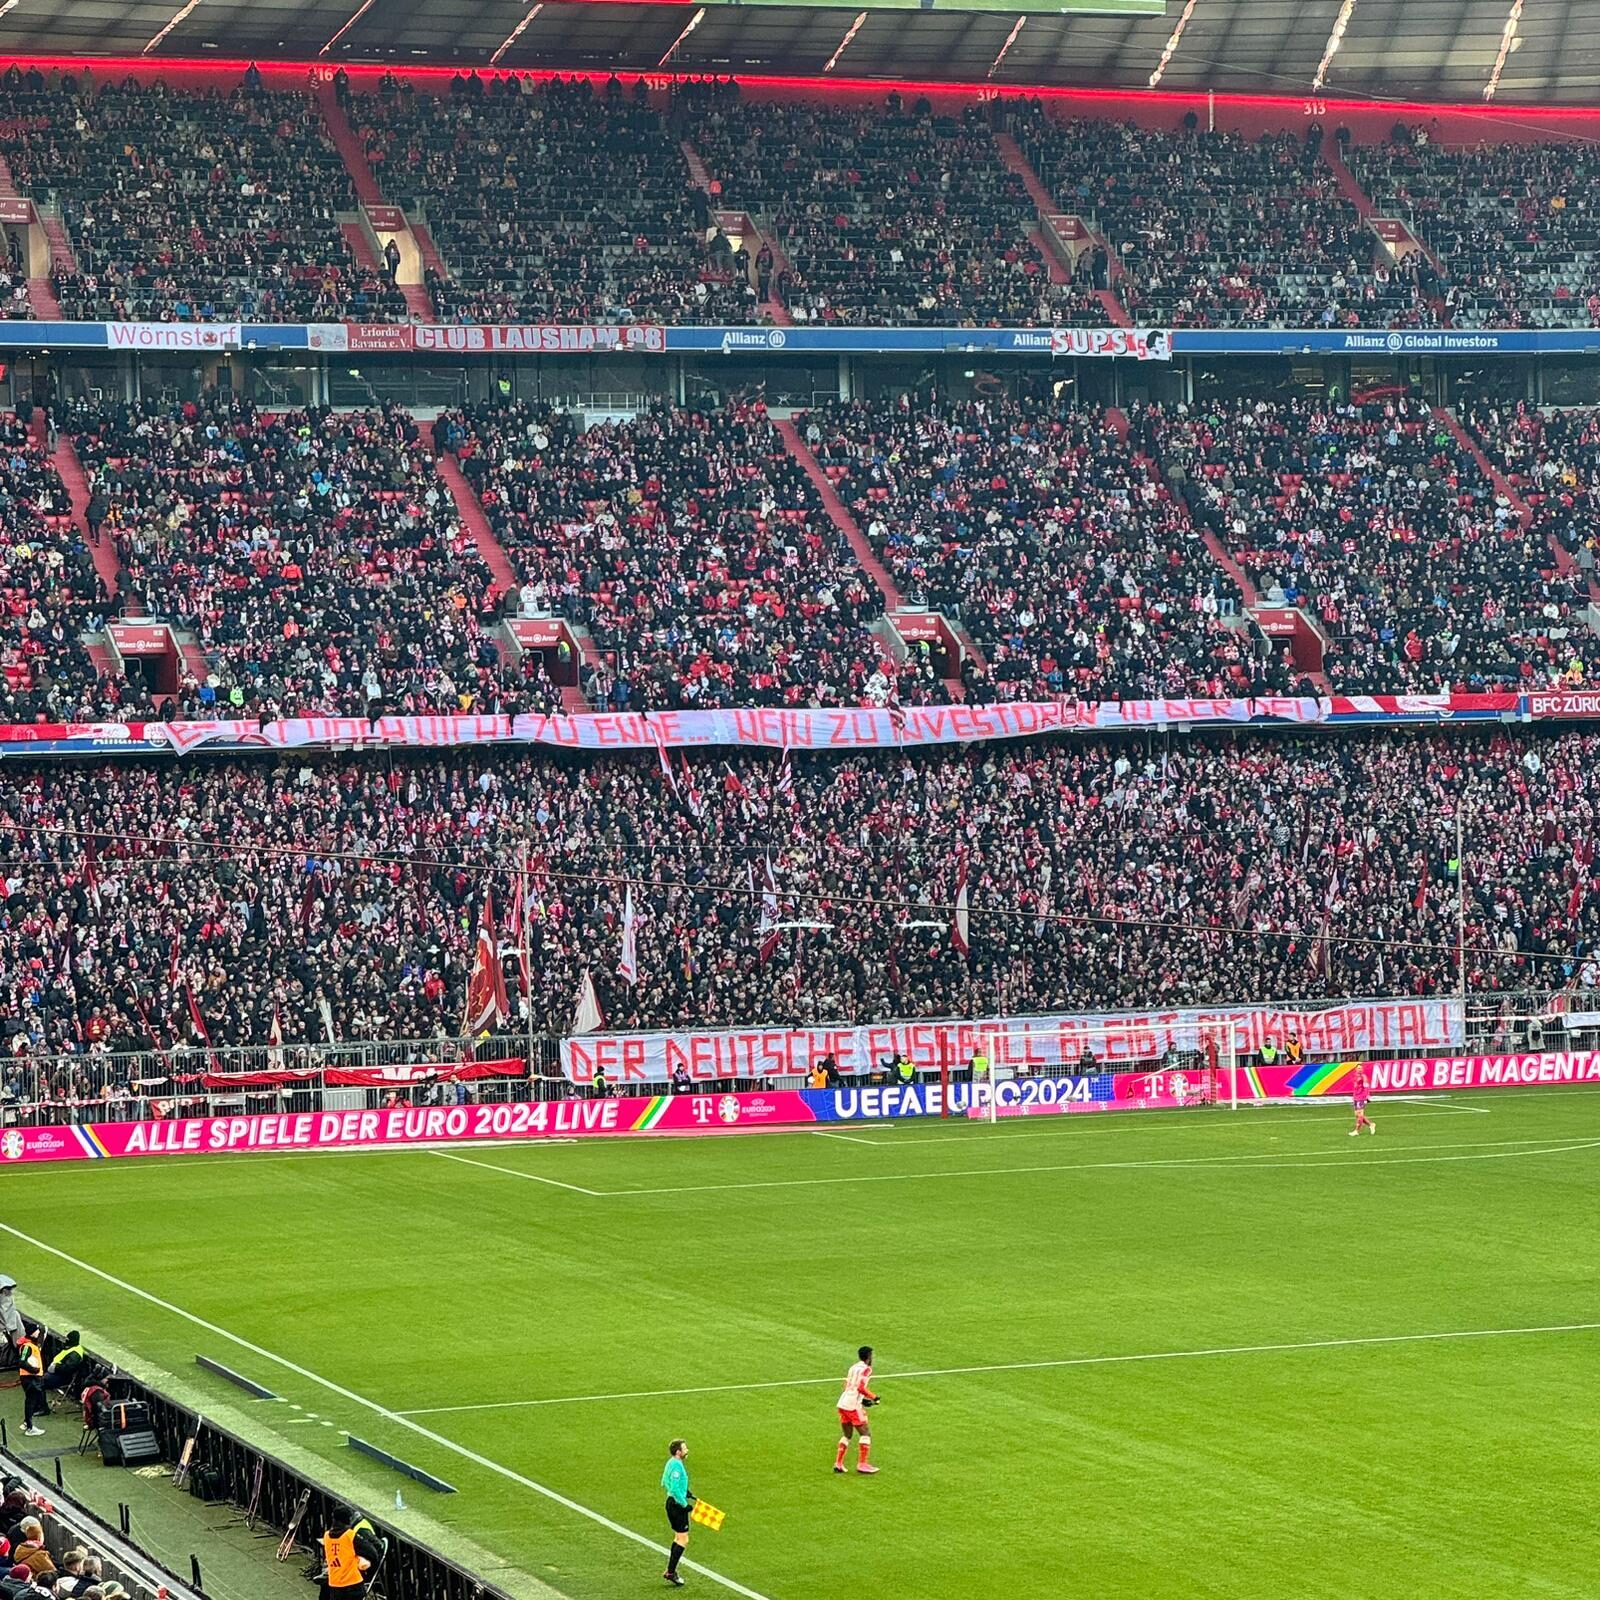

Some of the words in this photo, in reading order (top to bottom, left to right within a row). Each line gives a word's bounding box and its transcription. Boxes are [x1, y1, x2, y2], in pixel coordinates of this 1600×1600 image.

[319, 68, 334, 81] 16
[1303, 101, 1326, 115] 313
[360, 326, 400, 337] Erfordia
[415, 327, 485, 349] CLUB
[492, 327, 619, 349] LAUSHAM
[630, 328, 662, 349] 98
[723, 331, 766, 344] Allianz
[350, 337, 391, 348] Bavaria
[1052, 329, 1128, 354] SUPS
[1344, 335, 1386, 348] Allianz
[1404, 335, 1443, 348] Global
[1445, 335, 1498, 348] Investors
[1532, 697, 1561, 713] BFC
[528, 713, 578, 745] ZU
[829, 708, 878, 744] ZU
[890, 700, 1098, 742] INVESTOREN
[569, 1039, 646, 1082] DER
[664, 1031, 854, 1080] DEUTSCHE
[869, 1022, 1046, 1069] FUSSBALL
[1059, 1012, 1178, 1062] BLEIBT
[1371, 1059, 1428, 1089] NUR
[1432, 1058, 1475, 1086] BEI
[1480, 1051, 1600, 1084] MAGENTA
[124, 1118, 204, 1153] ALLE
[208, 1112, 313, 1149] SPIELE
[319, 1111, 379, 1142] DER
[386, 1107, 469, 1139] EURO
[474, 1103, 548, 1135] 2024
[554, 1100, 619, 1132] LIVE
